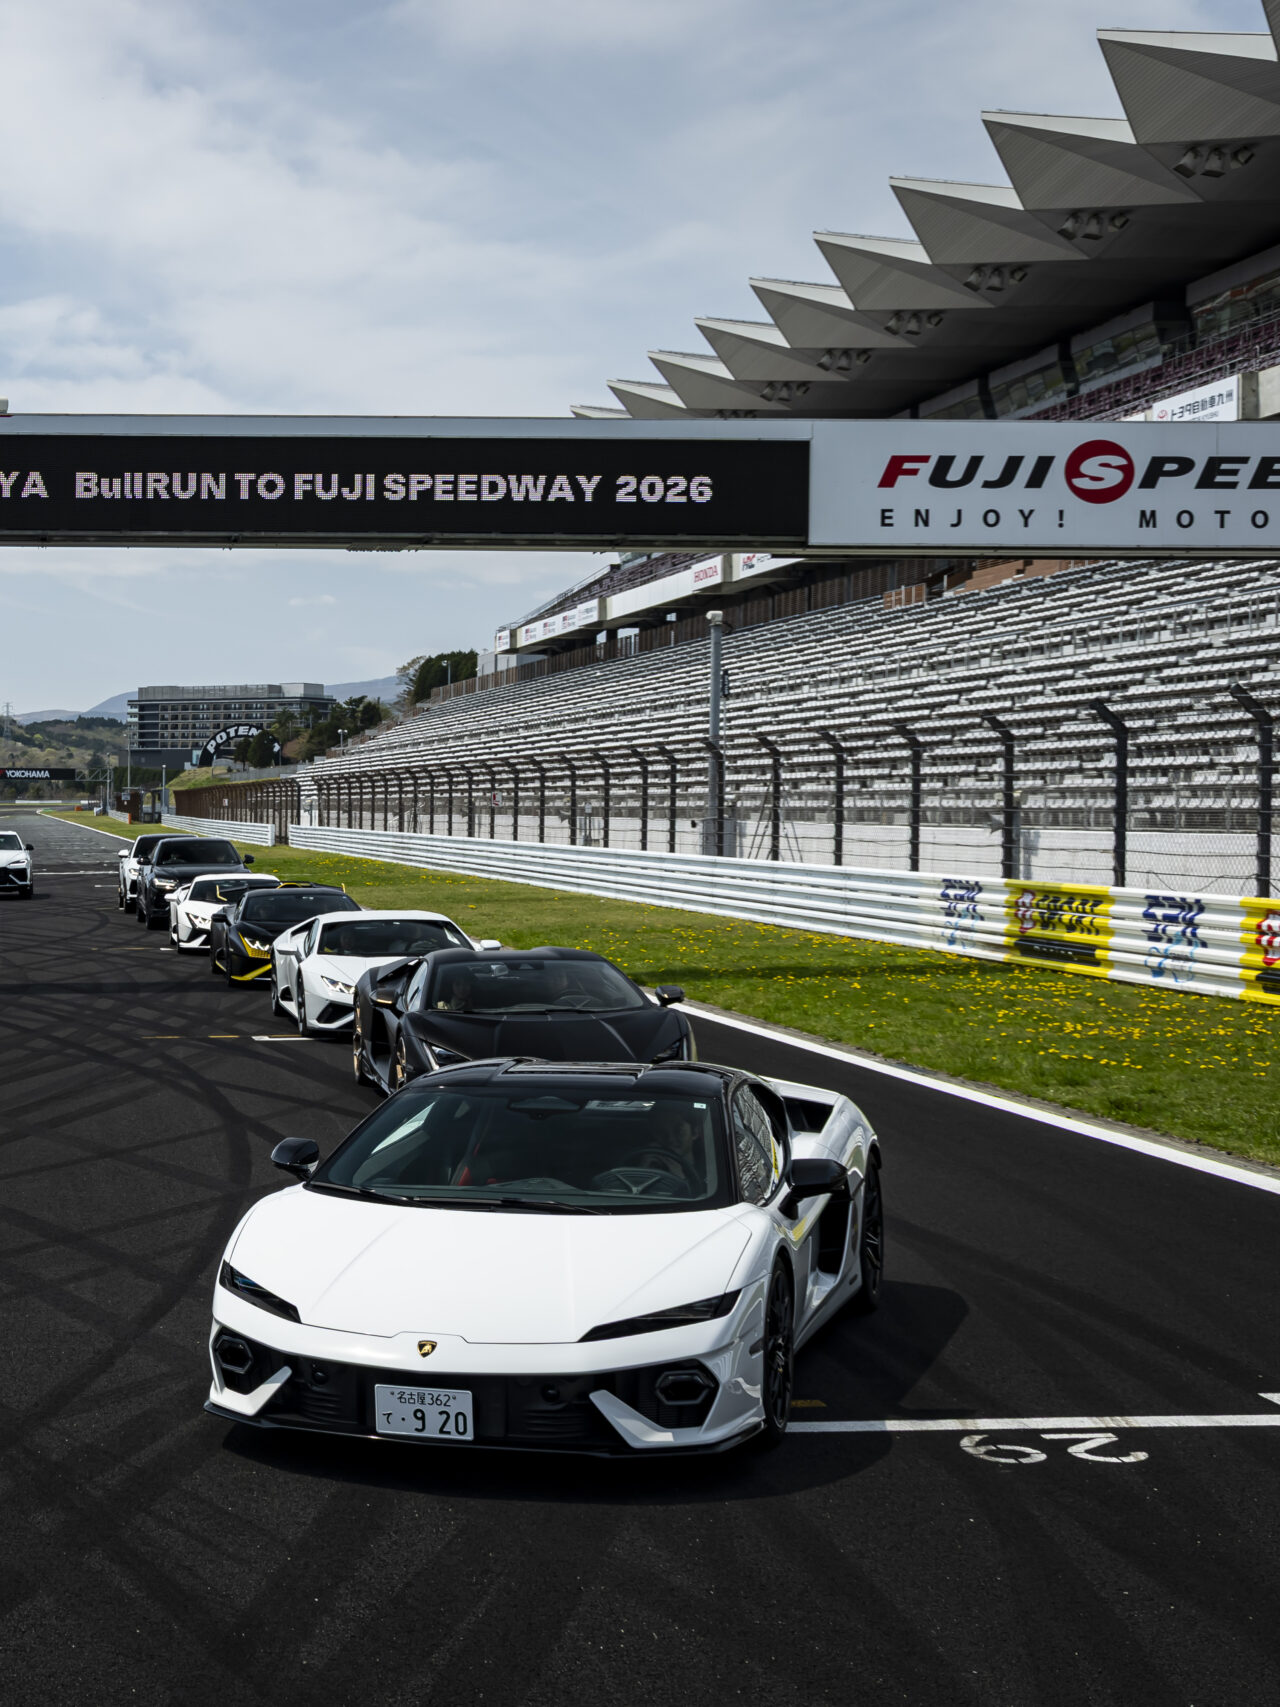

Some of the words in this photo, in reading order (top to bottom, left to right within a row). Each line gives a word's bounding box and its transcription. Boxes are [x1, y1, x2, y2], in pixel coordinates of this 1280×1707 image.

[877, 455, 1056, 489] FUJI
[75, 471, 226, 499] BullRUN
[234, 472, 286, 500] TO
[294, 473, 375, 500] FUJI
[383, 473, 602, 502] SPEEDWAY
[616, 475, 713, 503] 2026
[880, 509, 1065, 528] ENJOY!
[6, 770, 50, 778] YOKOHAMA
[427, 1393, 452, 1407] 362
